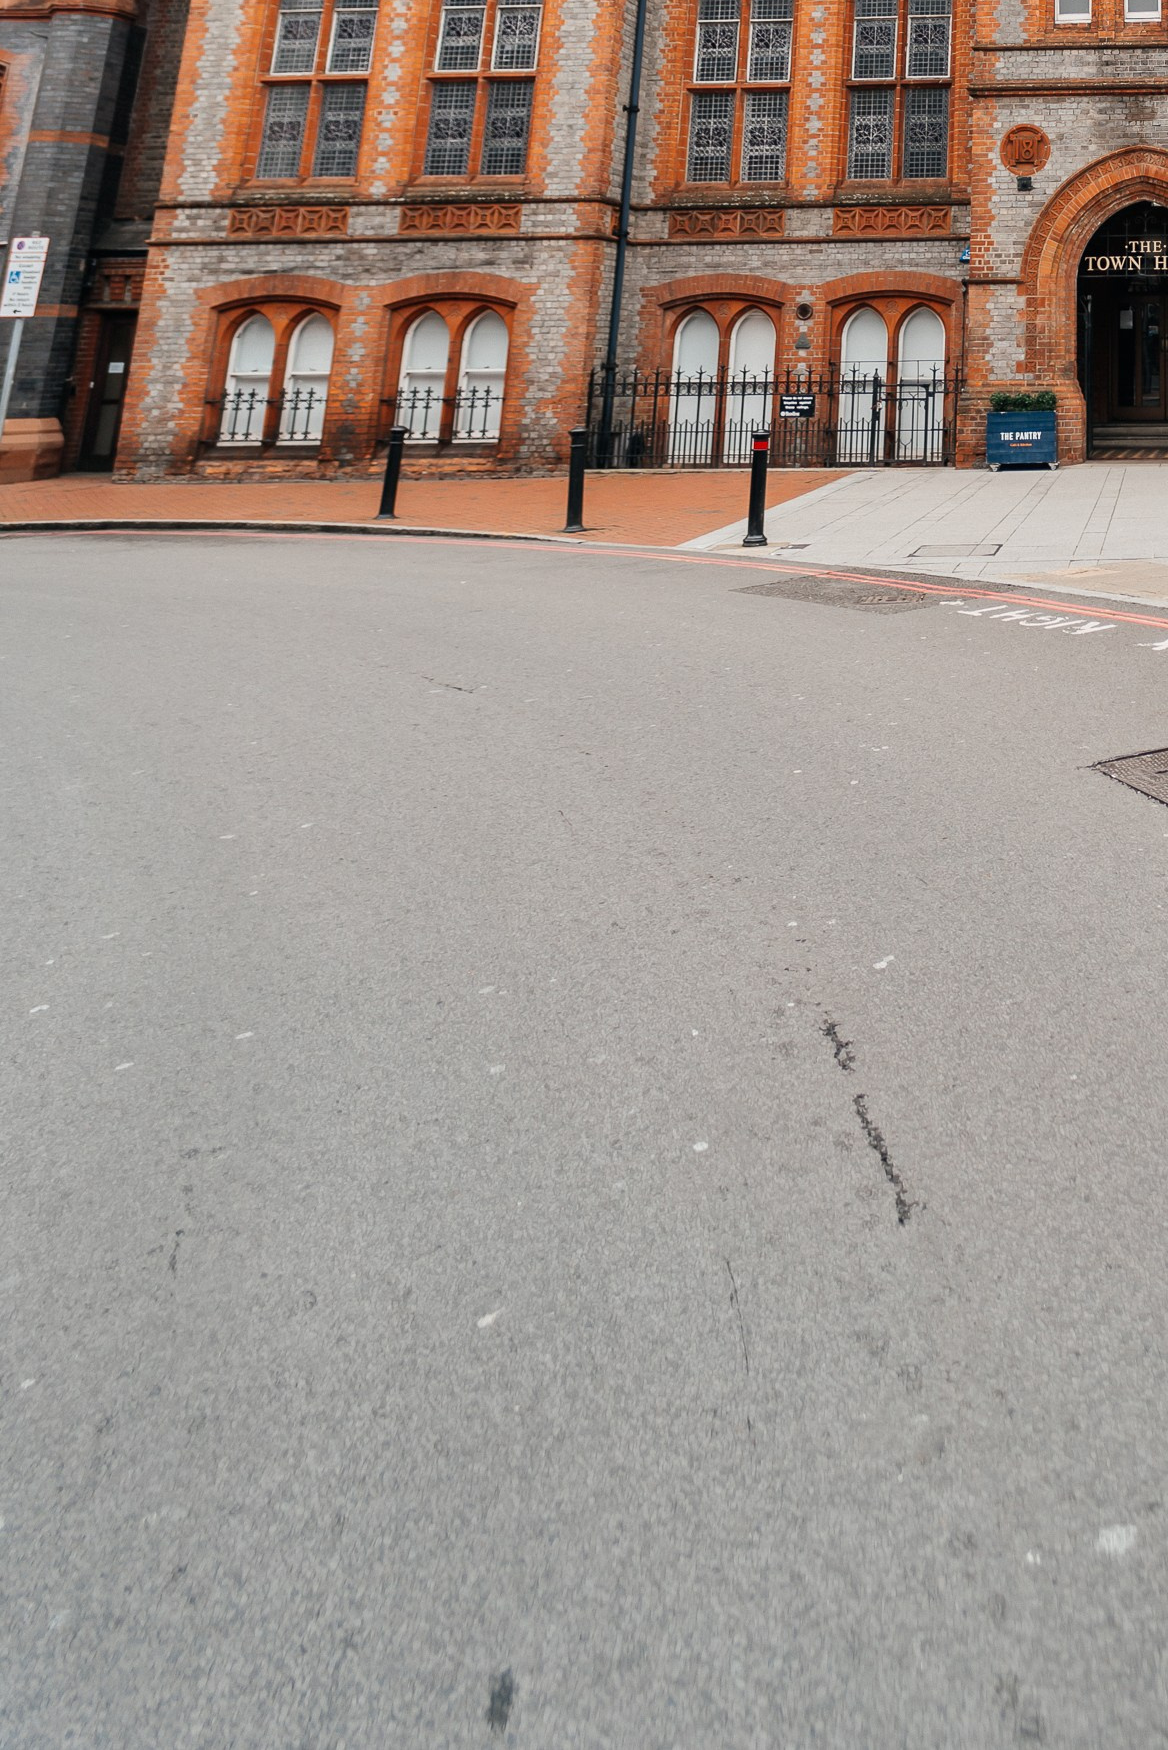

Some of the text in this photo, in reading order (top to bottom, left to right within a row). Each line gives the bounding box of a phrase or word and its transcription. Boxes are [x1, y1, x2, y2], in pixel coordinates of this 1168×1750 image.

[1014, 138, 1034, 160] 18
[1085, 256, 1142, 271] TOWN
[1000, 431, 1041, 440] THE PANTRY
[957, 604, 1117, 635] RIGHT
